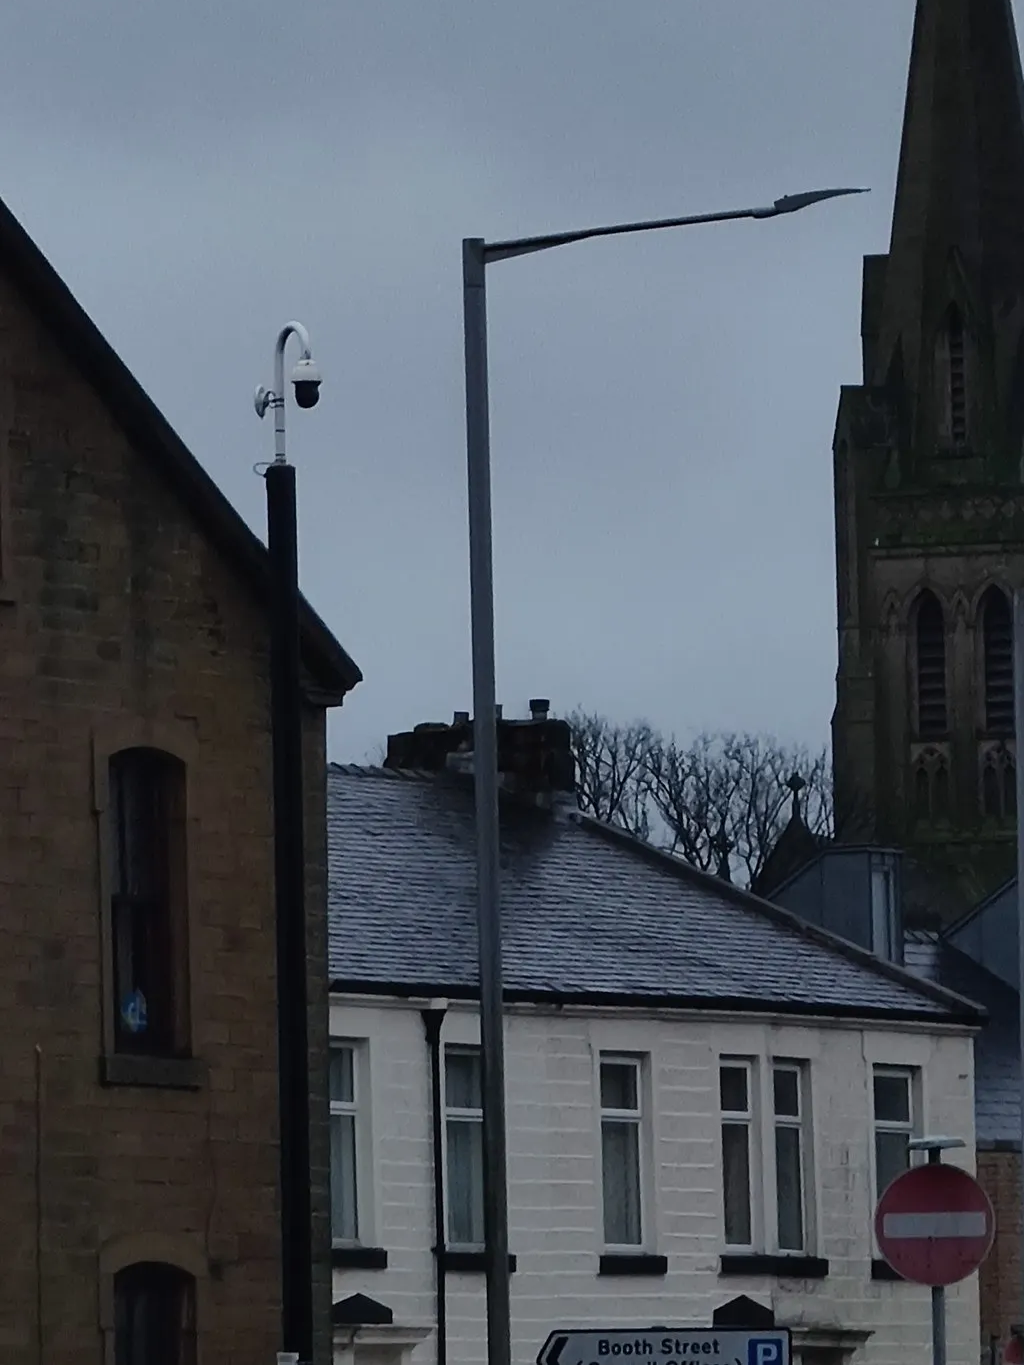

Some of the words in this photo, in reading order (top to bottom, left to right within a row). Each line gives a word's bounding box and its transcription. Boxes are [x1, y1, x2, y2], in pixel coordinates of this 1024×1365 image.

[598, 1339, 653, 1356] Booth
[661, 1338, 720, 1355] Street
[756, 1343, 778, 1365] P
